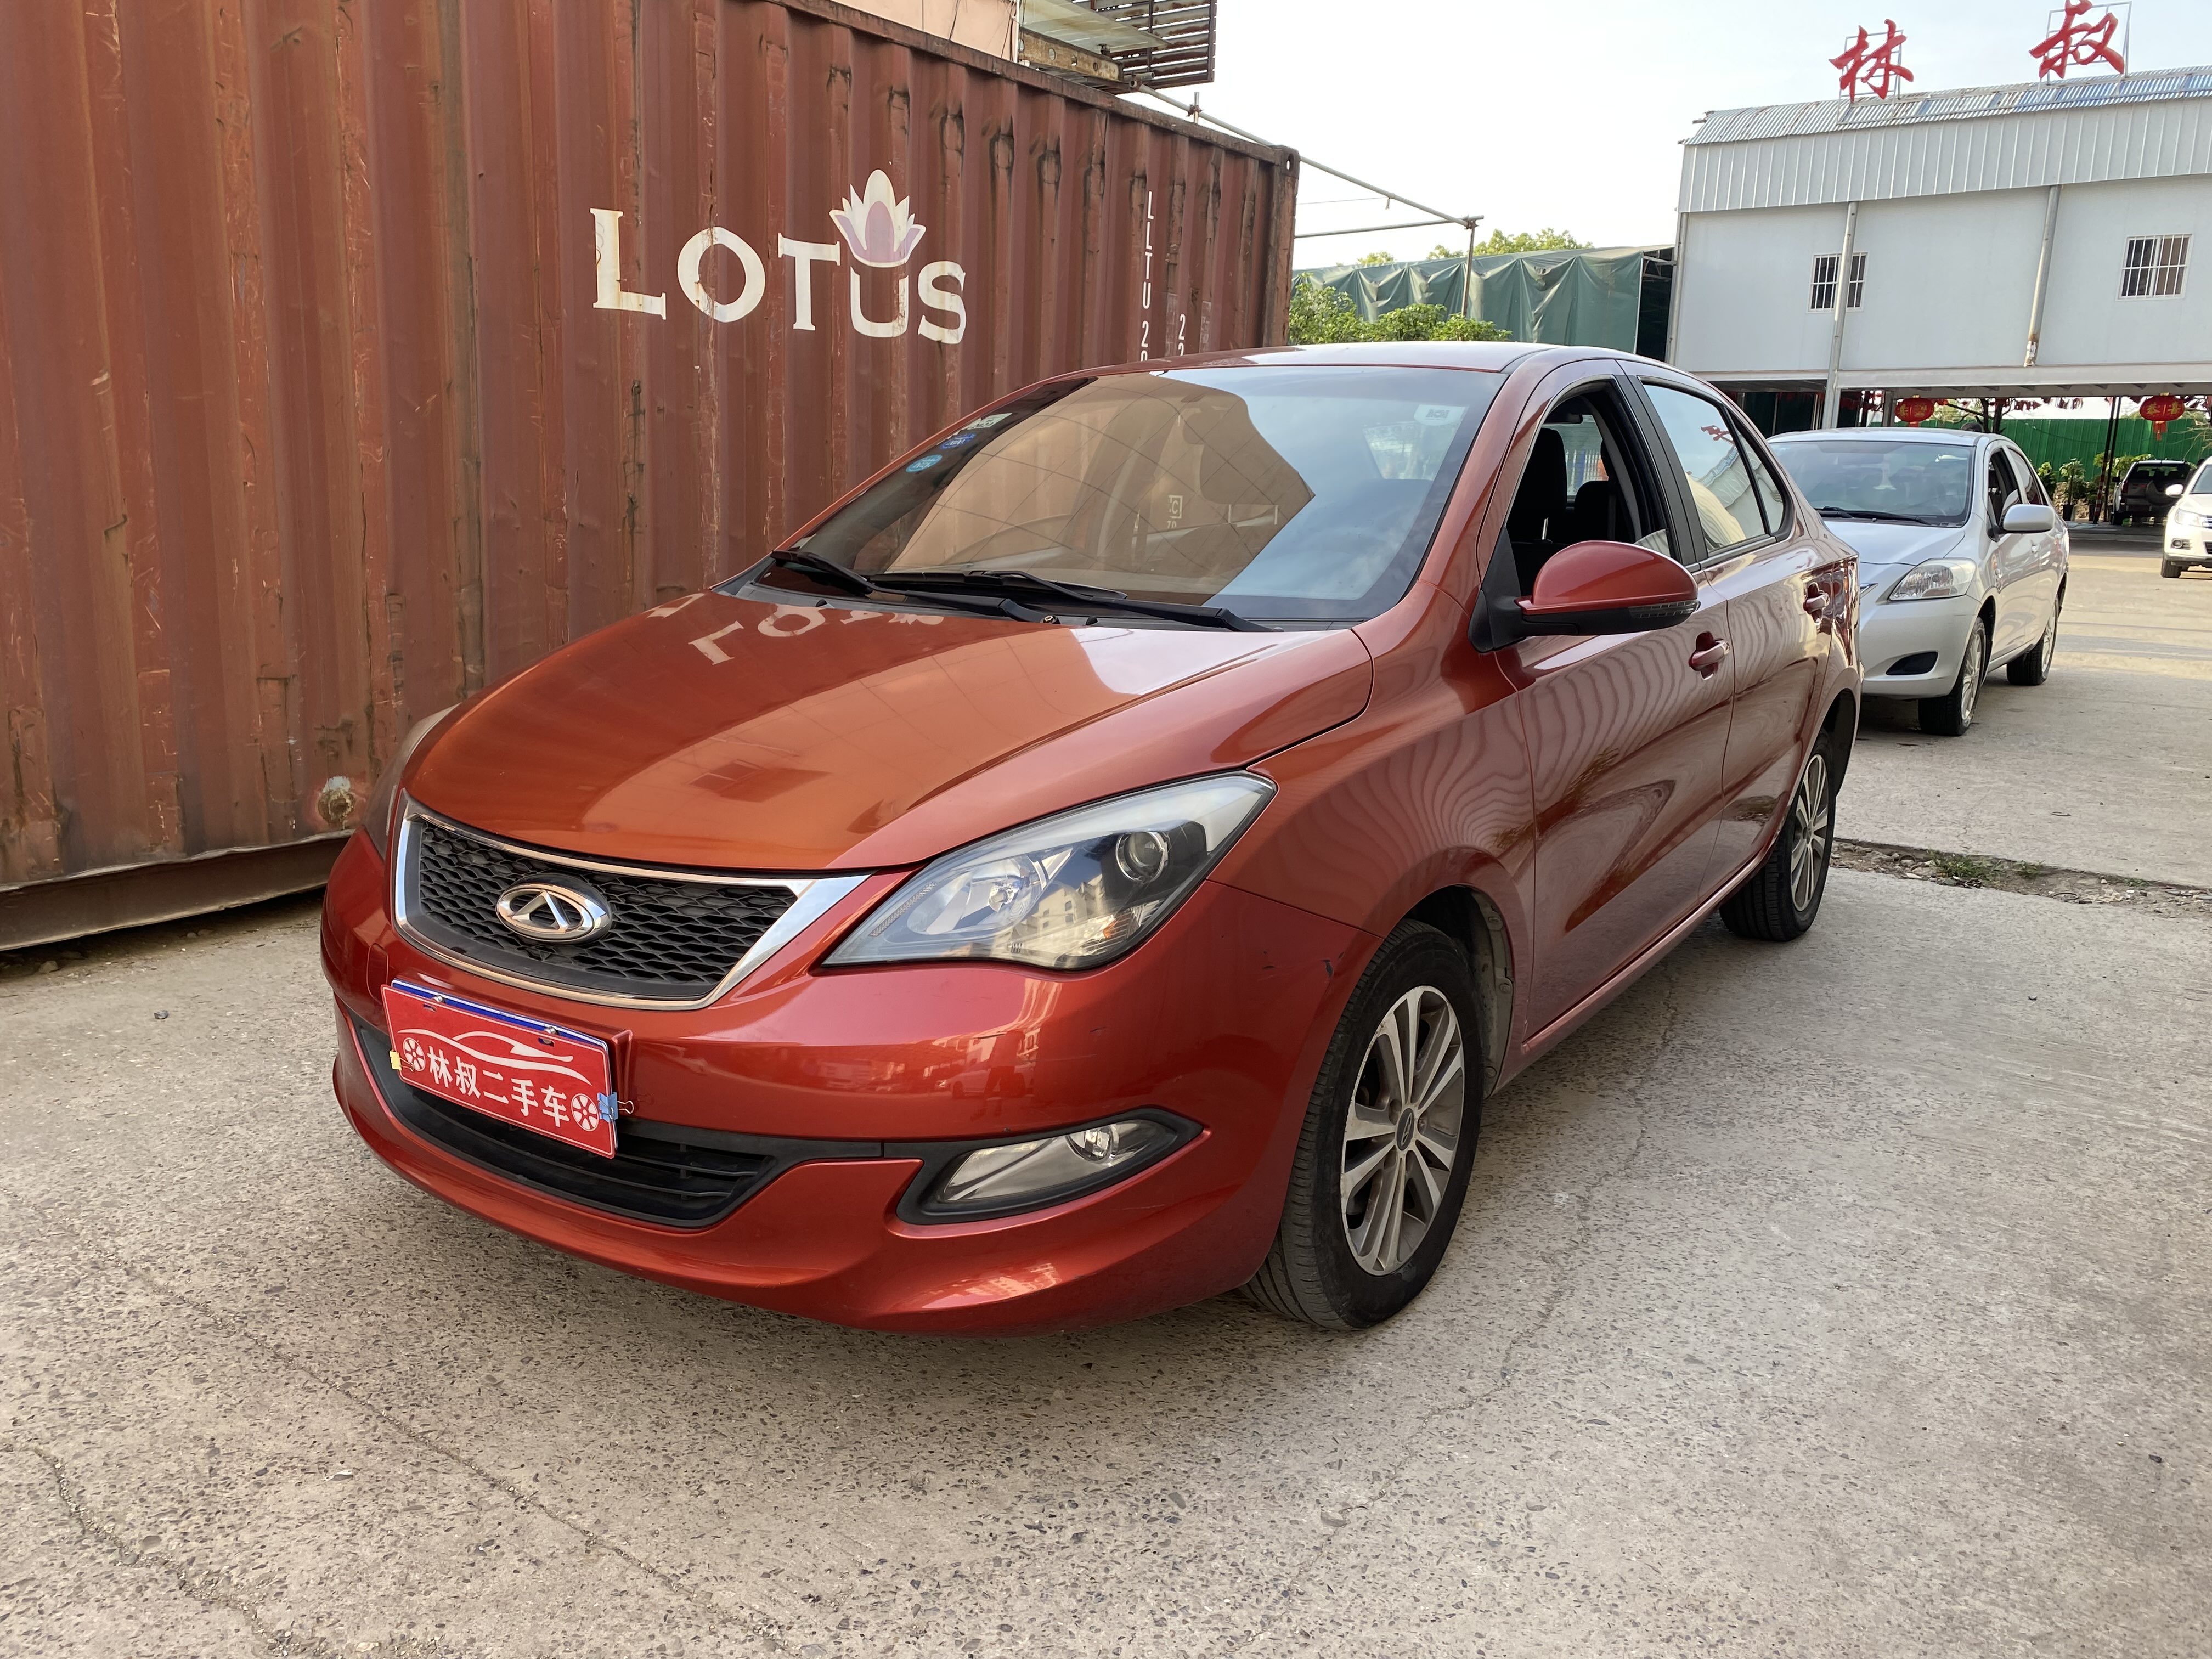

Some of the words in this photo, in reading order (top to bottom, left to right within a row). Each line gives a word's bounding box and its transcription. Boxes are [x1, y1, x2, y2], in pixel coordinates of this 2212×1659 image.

[590, 208, 967, 345] LOTUS
[1142, 191, 1154, 309] LLTU
[427, 1046, 570, 1128] 林叔二手车
